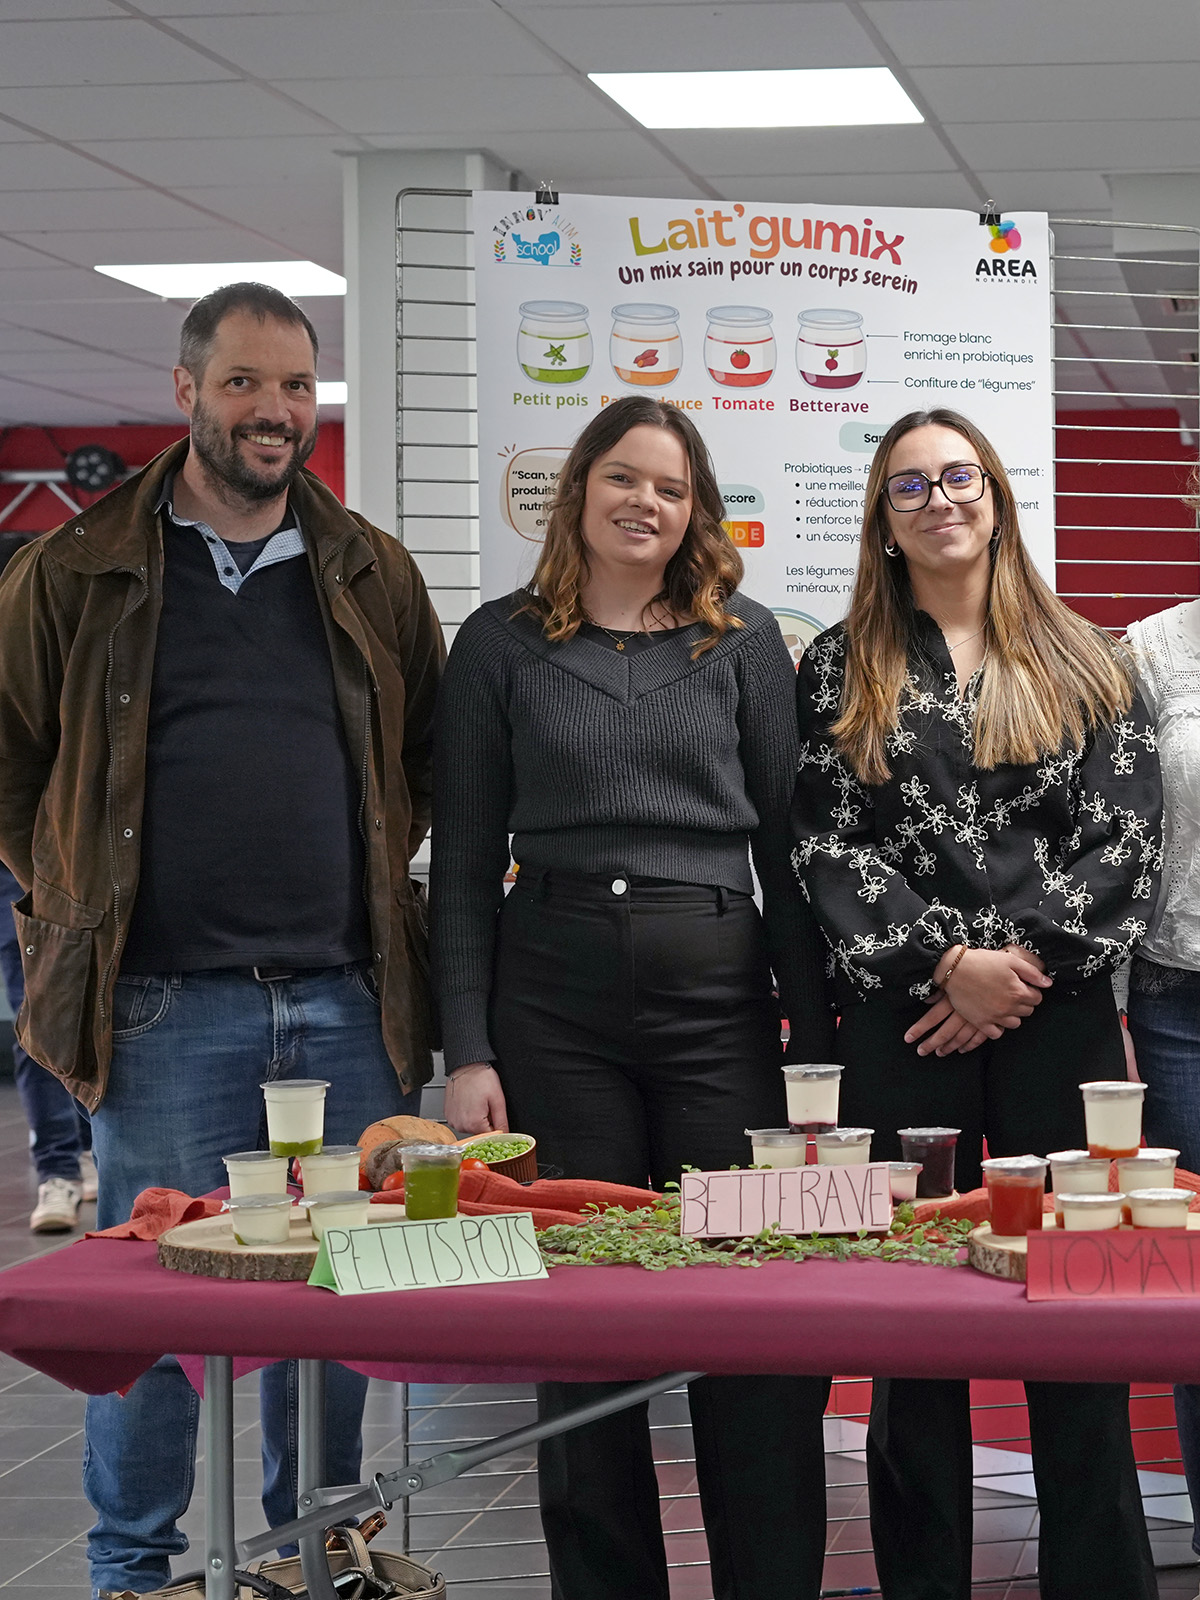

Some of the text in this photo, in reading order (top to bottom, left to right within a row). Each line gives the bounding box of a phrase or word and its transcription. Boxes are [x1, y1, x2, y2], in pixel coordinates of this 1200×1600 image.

[629, 204, 905, 265] Lait'gumix
[975, 258, 1037, 278] AREA
[618, 258, 918, 295] Un mix sain pour un corps serein
[975, 277, 1038, 285] NORMANDIE
[903, 331, 992, 346] Fromage blanc
[903, 349, 1034, 365] enrichi en probiotiques
[904, 377, 958, 389] Confiture
[960, 378, 976, 390] de
[513, 392, 551, 406] Petit
[556, 393, 589, 409] pois
[712, 396, 775, 411] Tomate
[789, 399, 869, 413] Betterave
[784, 463, 853, 476] Probiotiques
[511, 485, 557, 498] produits
[805, 482, 827, 491] une
[805, 497, 858, 508] réduction
[805, 514, 852, 525] renforce
[734, 527, 760, 541] D E
[806, 533, 821, 542] un
[786, 565, 855, 579] Les légumes
[786, 582, 841, 594] minéraux,
[682, 1167, 890, 1235] BETTERAVE
[327, 1221, 463, 1291] PETITS
